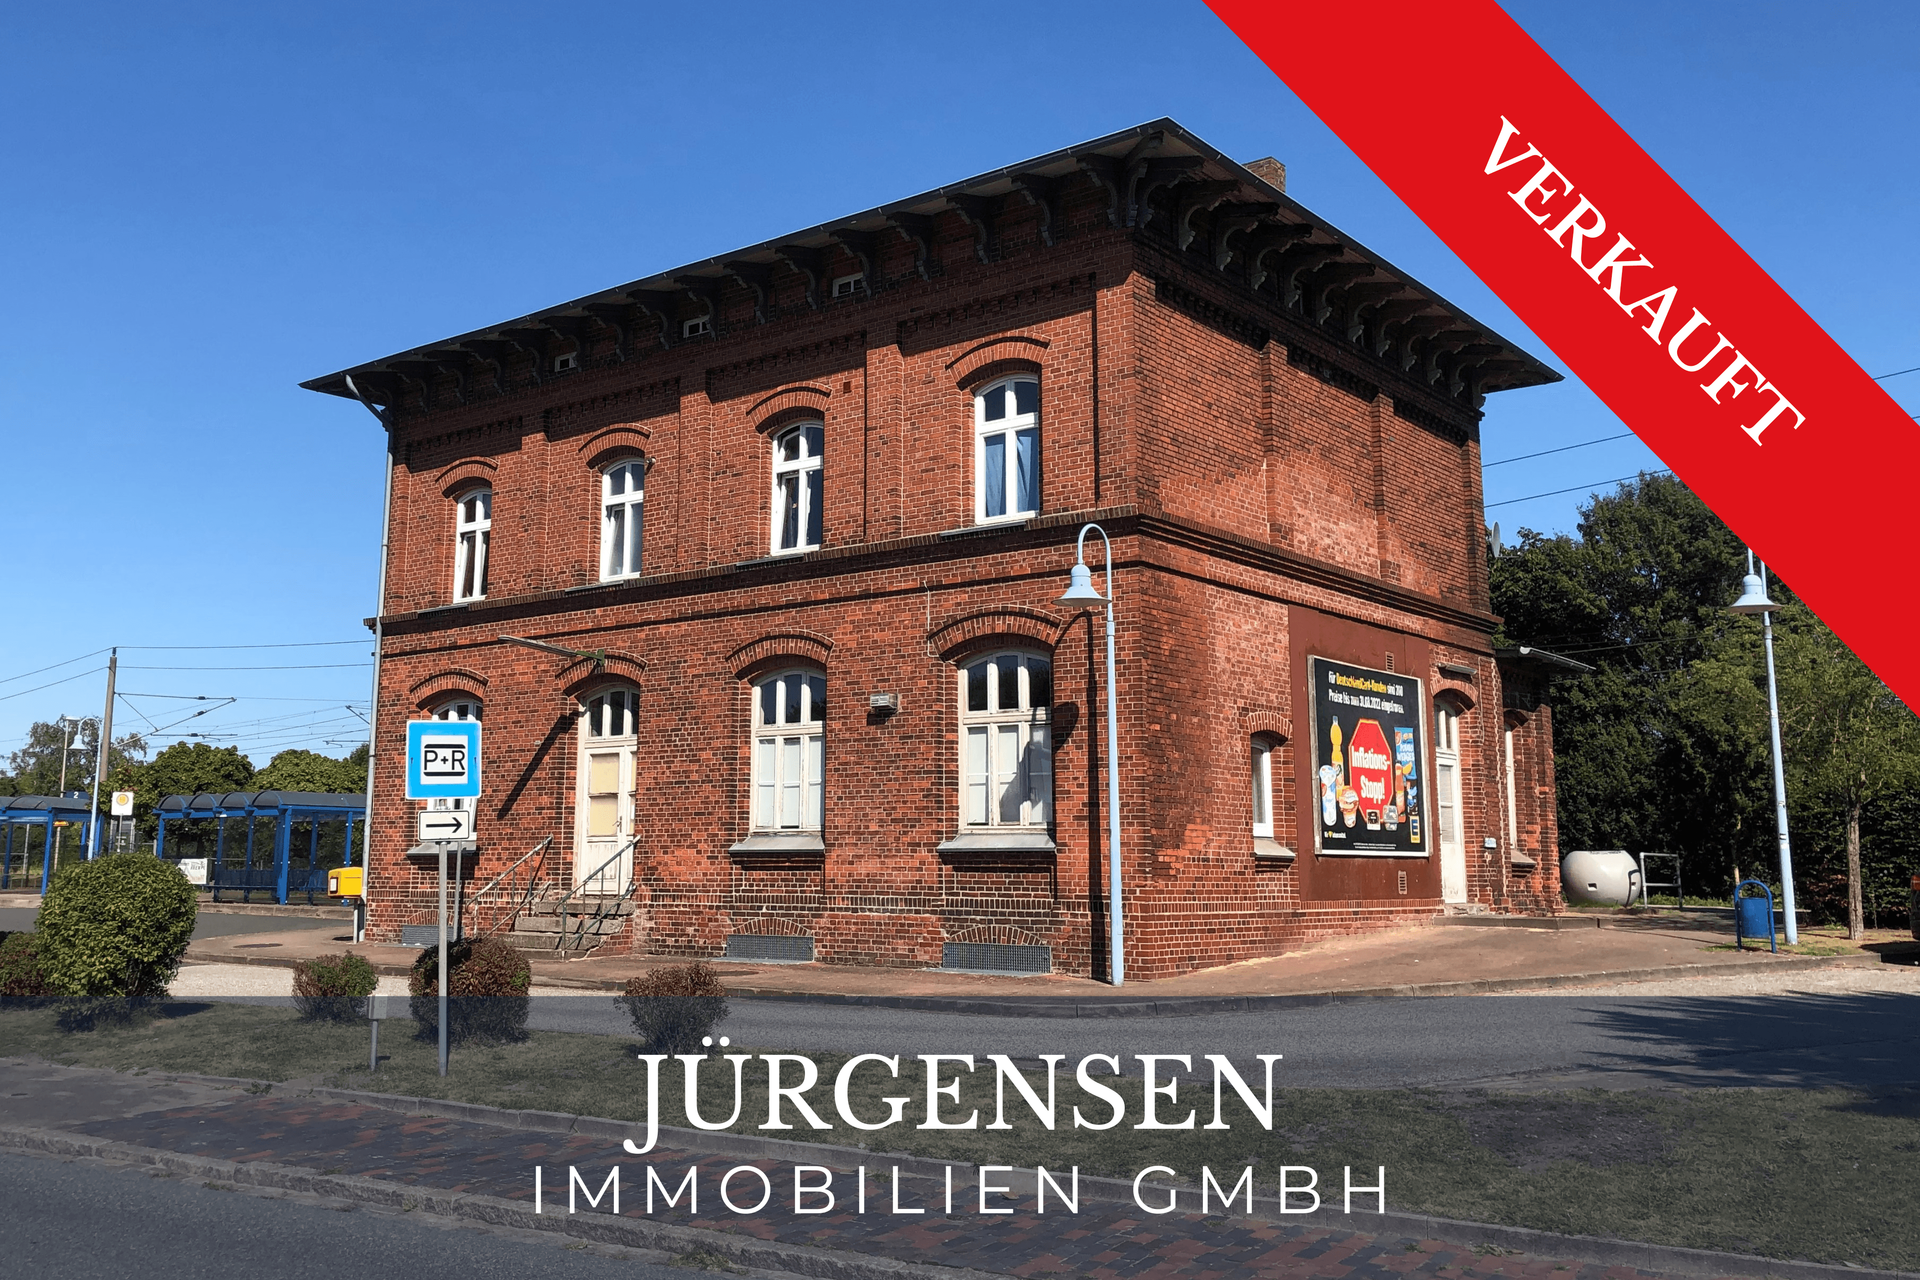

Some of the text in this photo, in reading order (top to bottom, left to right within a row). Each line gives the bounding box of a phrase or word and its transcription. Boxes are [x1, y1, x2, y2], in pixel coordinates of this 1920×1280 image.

[1328, 688, 1343, 704] Preise
[424, 750, 465, 770] P+R
[1351, 745, 1390, 771] Inflations-
[73, 791, 79, 799] 2
[1360, 775, 1385, 804] Stopp!
